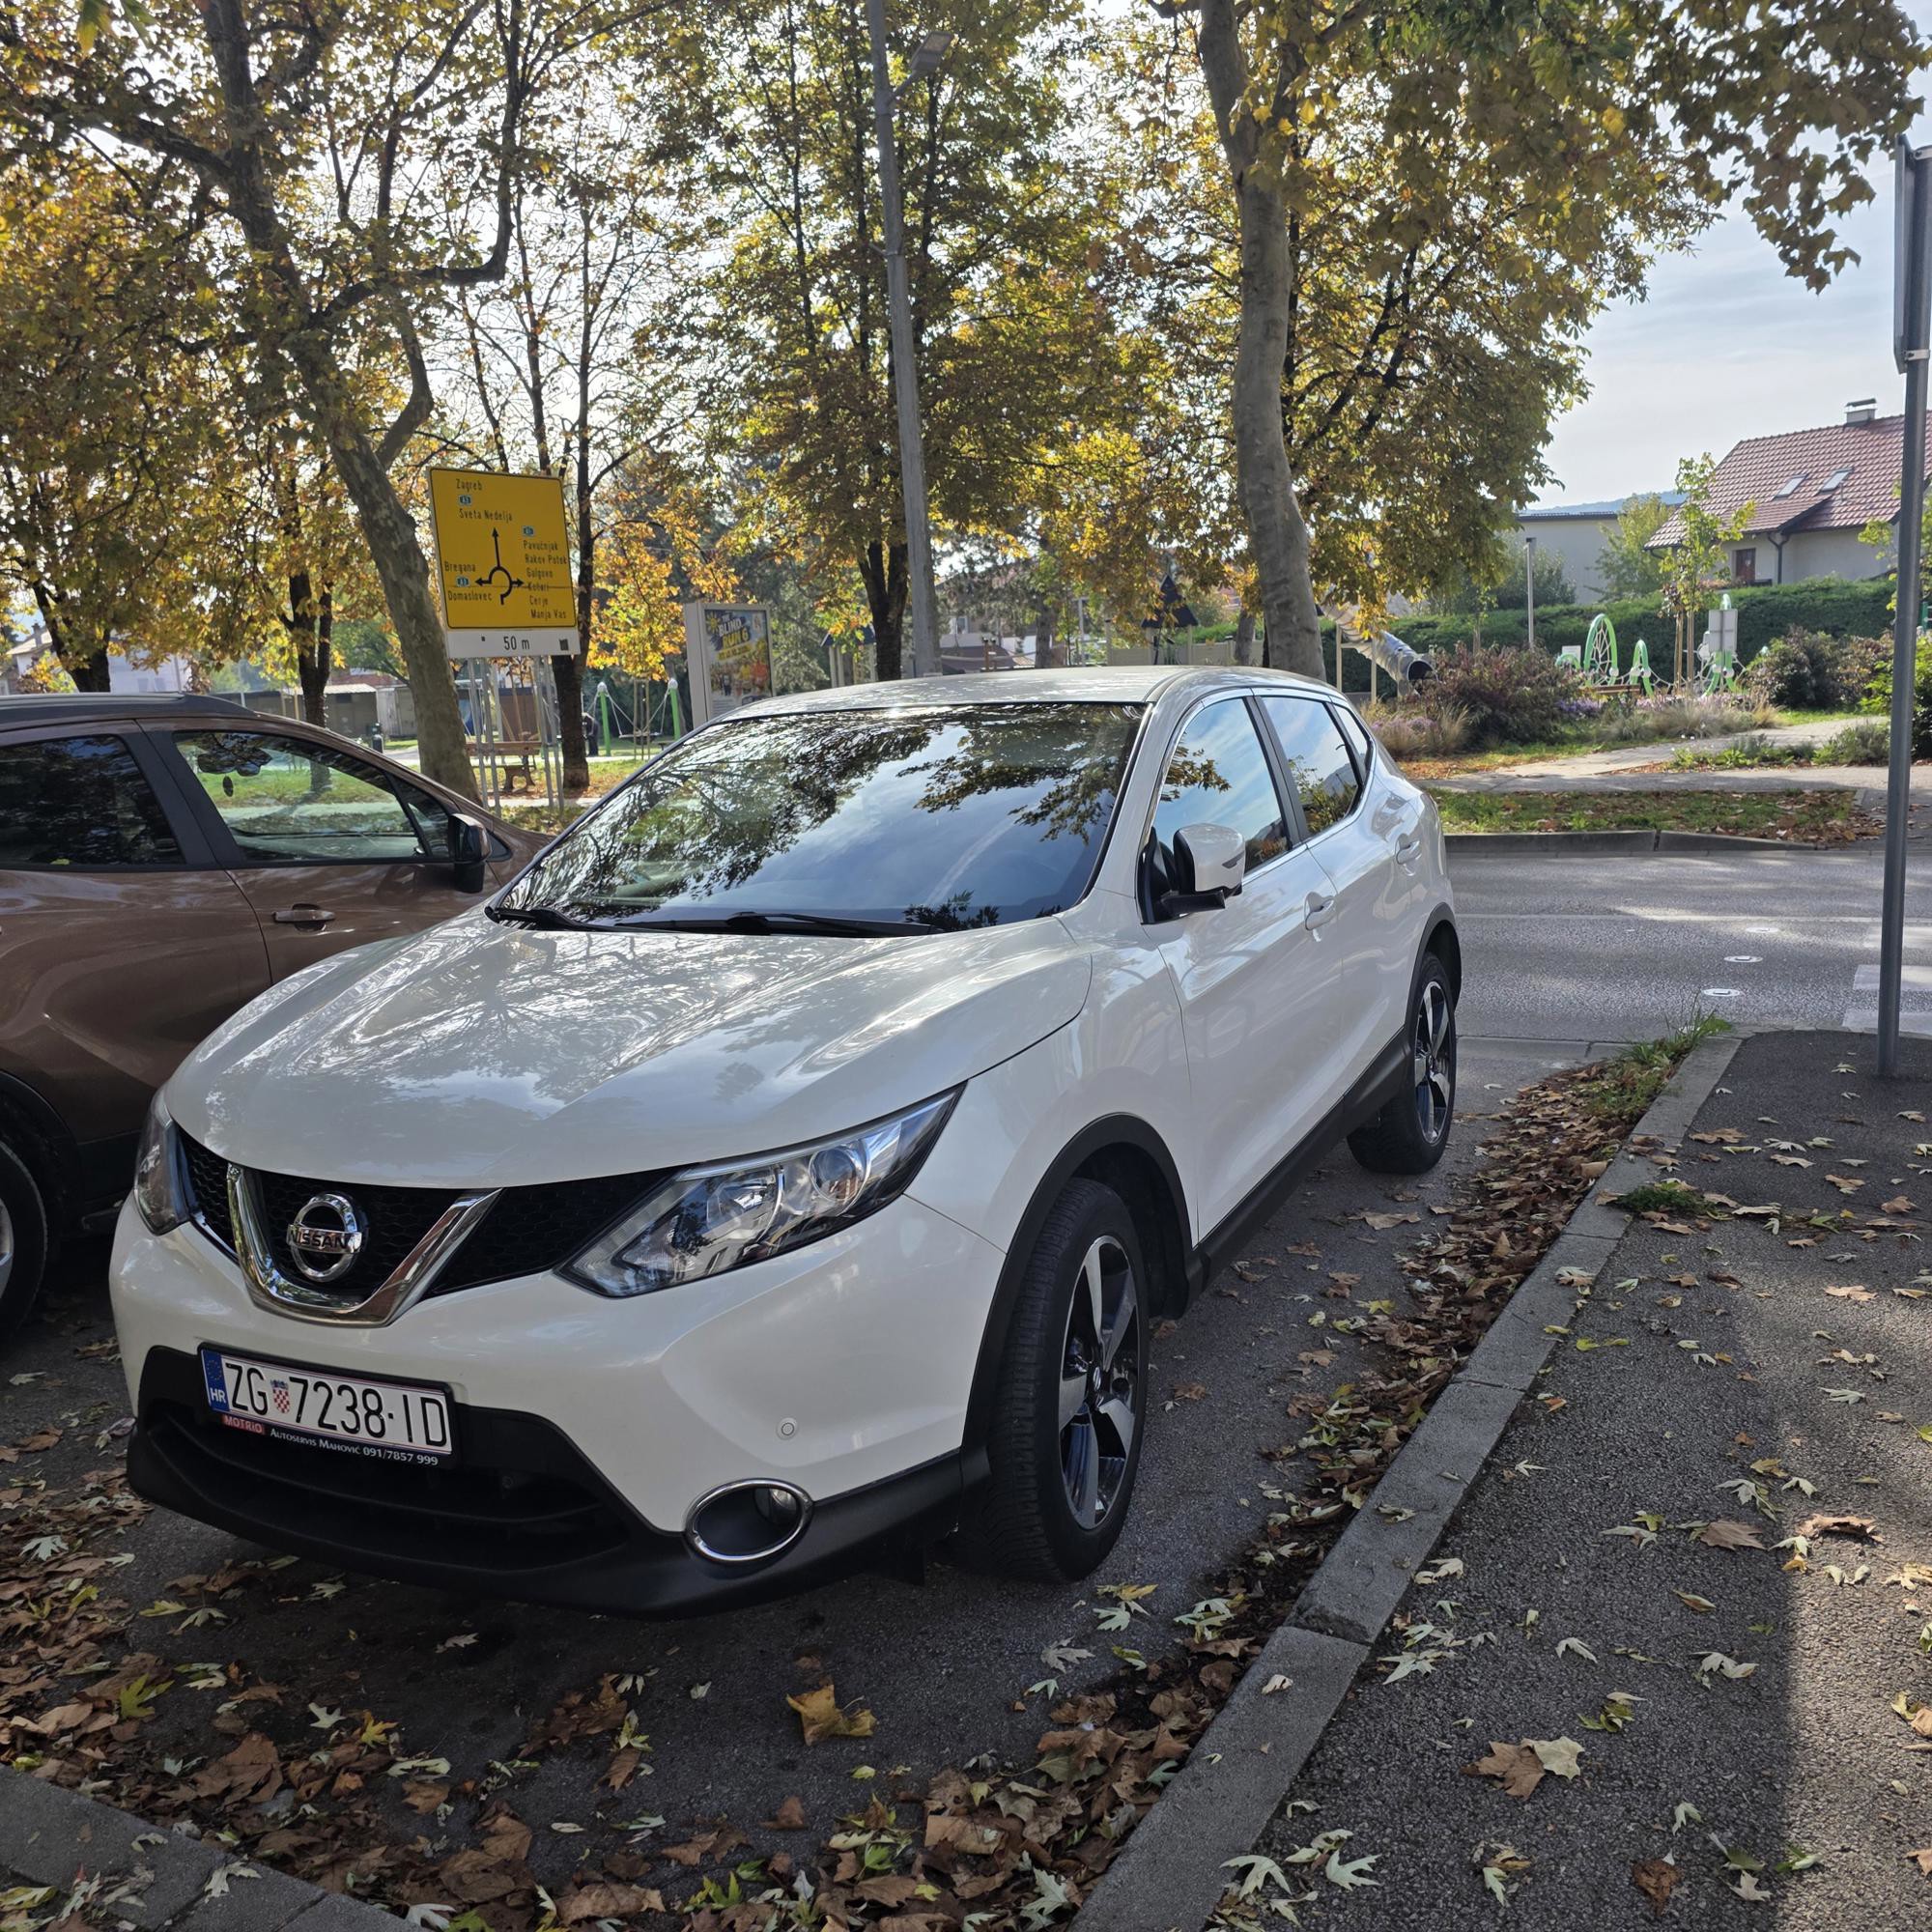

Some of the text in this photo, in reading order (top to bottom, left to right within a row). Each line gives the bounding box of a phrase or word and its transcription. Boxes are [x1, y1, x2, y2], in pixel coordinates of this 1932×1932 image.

[456, 478, 483, 492] Zagreb
[459, 508, 513, 523] Sveta Nedelja
[526, 554, 568, 565] Rakov Potok
[444, 561, 476, 574] Bregana
[447, 590, 493, 602] Domaslovec
[529, 595, 549, 608] Cerje
[530, 610, 567, 621] Manja Vas
[503, 636, 530, 651] 50 m
[723, 630, 741, 649] RUN
[291, 1226, 356, 1252] NISSAN
[210, 1387, 227, 1404] HR
[225, 1362, 269, 1416] ZG
[363, 1446, 413, 1463] 091/7857
[416, 1454, 440, 1466] 999
